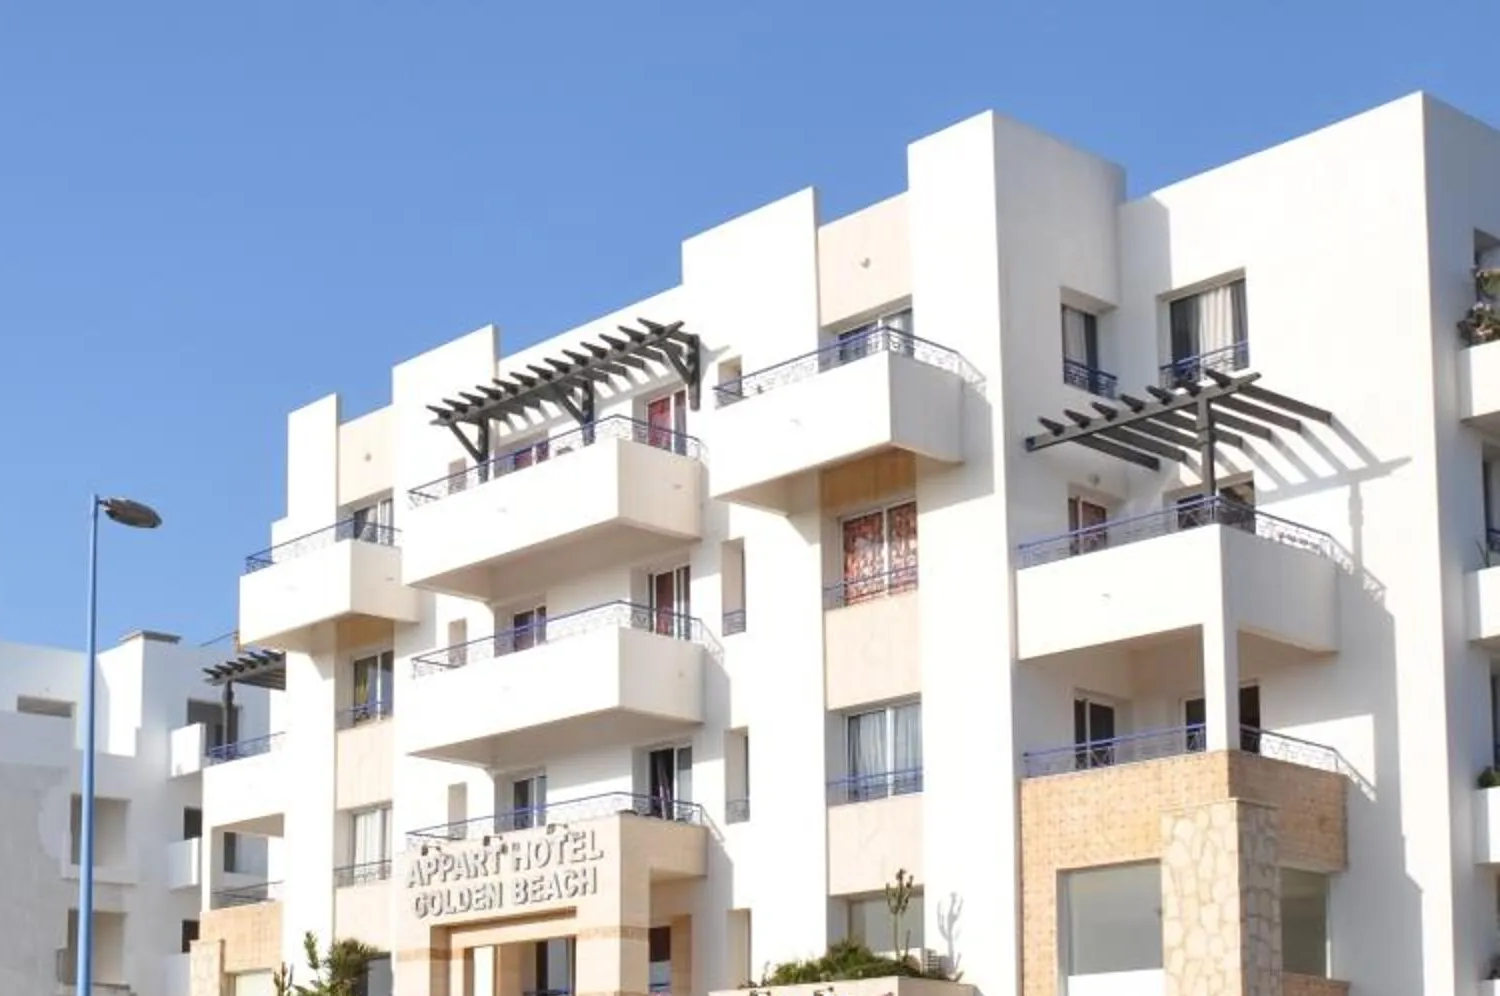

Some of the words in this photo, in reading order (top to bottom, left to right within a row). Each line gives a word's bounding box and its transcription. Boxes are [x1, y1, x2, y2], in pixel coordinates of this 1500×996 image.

[406, 845, 503, 889] APPART
[510, 828, 605, 872] HOTEL
[414, 880, 504, 919] GOLDEN
[512, 866, 599, 906] BEACH
